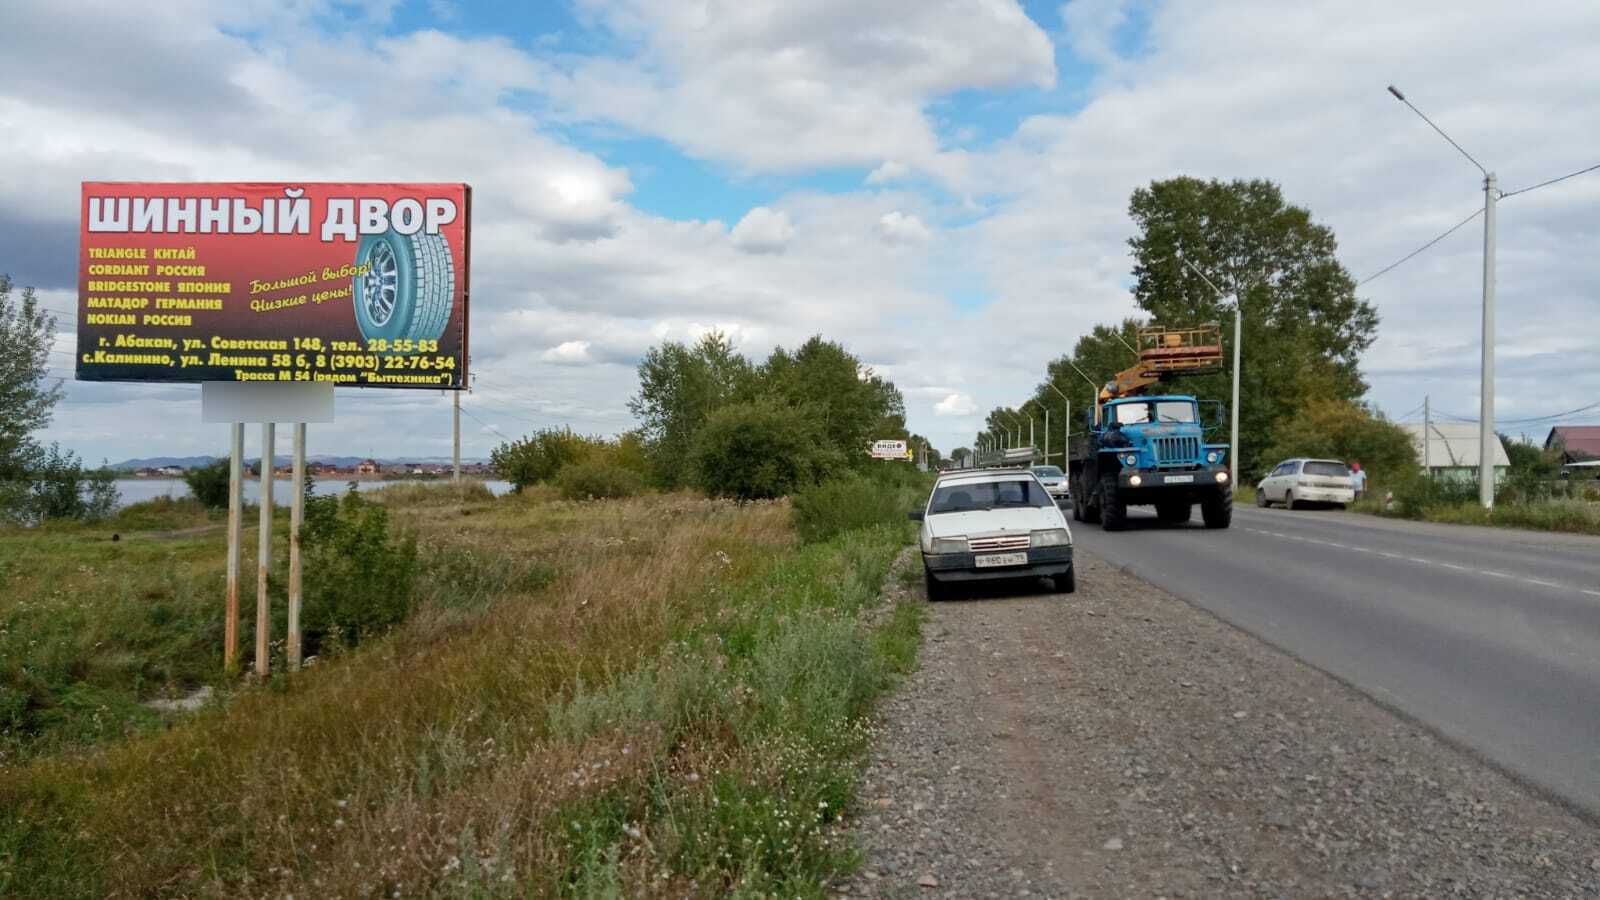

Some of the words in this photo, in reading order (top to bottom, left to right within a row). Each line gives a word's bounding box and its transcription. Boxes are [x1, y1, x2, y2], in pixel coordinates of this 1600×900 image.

[88, 187, 312, 234] ШИННЫЙ
[320, 198, 457, 242] ДВОР
[88, 247, 147, 259] TRIANGLE
[154, 246, 196, 260] КИТАЙ
[88, 264, 149, 276] CORDIANT
[156, 265, 206, 277] РОССИЯ
[249, 271, 317, 294] Большой
[321, 260, 371, 281] выбор!
[88, 281, 171, 292] BRIDGESTONE
[177, 282, 231, 293] ЯПОНИЯ
[87, 297, 149, 310] МАТАДОР
[155, 298, 223, 310] ГЕРМАНИЯ
[250, 295, 307, 312] Низкие
[311, 284, 353, 304] цены!
[87, 314, 136, 325] NOKIAN
[143, 315, 192, 326] РОССИЯ
[99, 337, 110, 347] г.
[115, 335, 178, 350] Абакан,
[182, 338, 206, 351] ул.
[211, 336, 287, 350] Советская
[293, 338, 326, 352] 148,
[330, 340, 362, 351] тел.
[367, 339, 438, 352] 28-55-83
[82, 351, 175, 367] с.Калинино,
[180, 355, 203, 368] ул.
[208, 353, 267, 367] Ленина
[271, 355, 291, 368] 58
[316, 355, 326, 368] 8
[330, 355, 380, 371] (3903)
[384, 356, 455, 369] 22-76-54
[235, 370, 275, 381] Трасса
[279, 371, 291, 381] М
[295, 371, 310, 381] 54
[313, 371, 357, 384] (рядом
